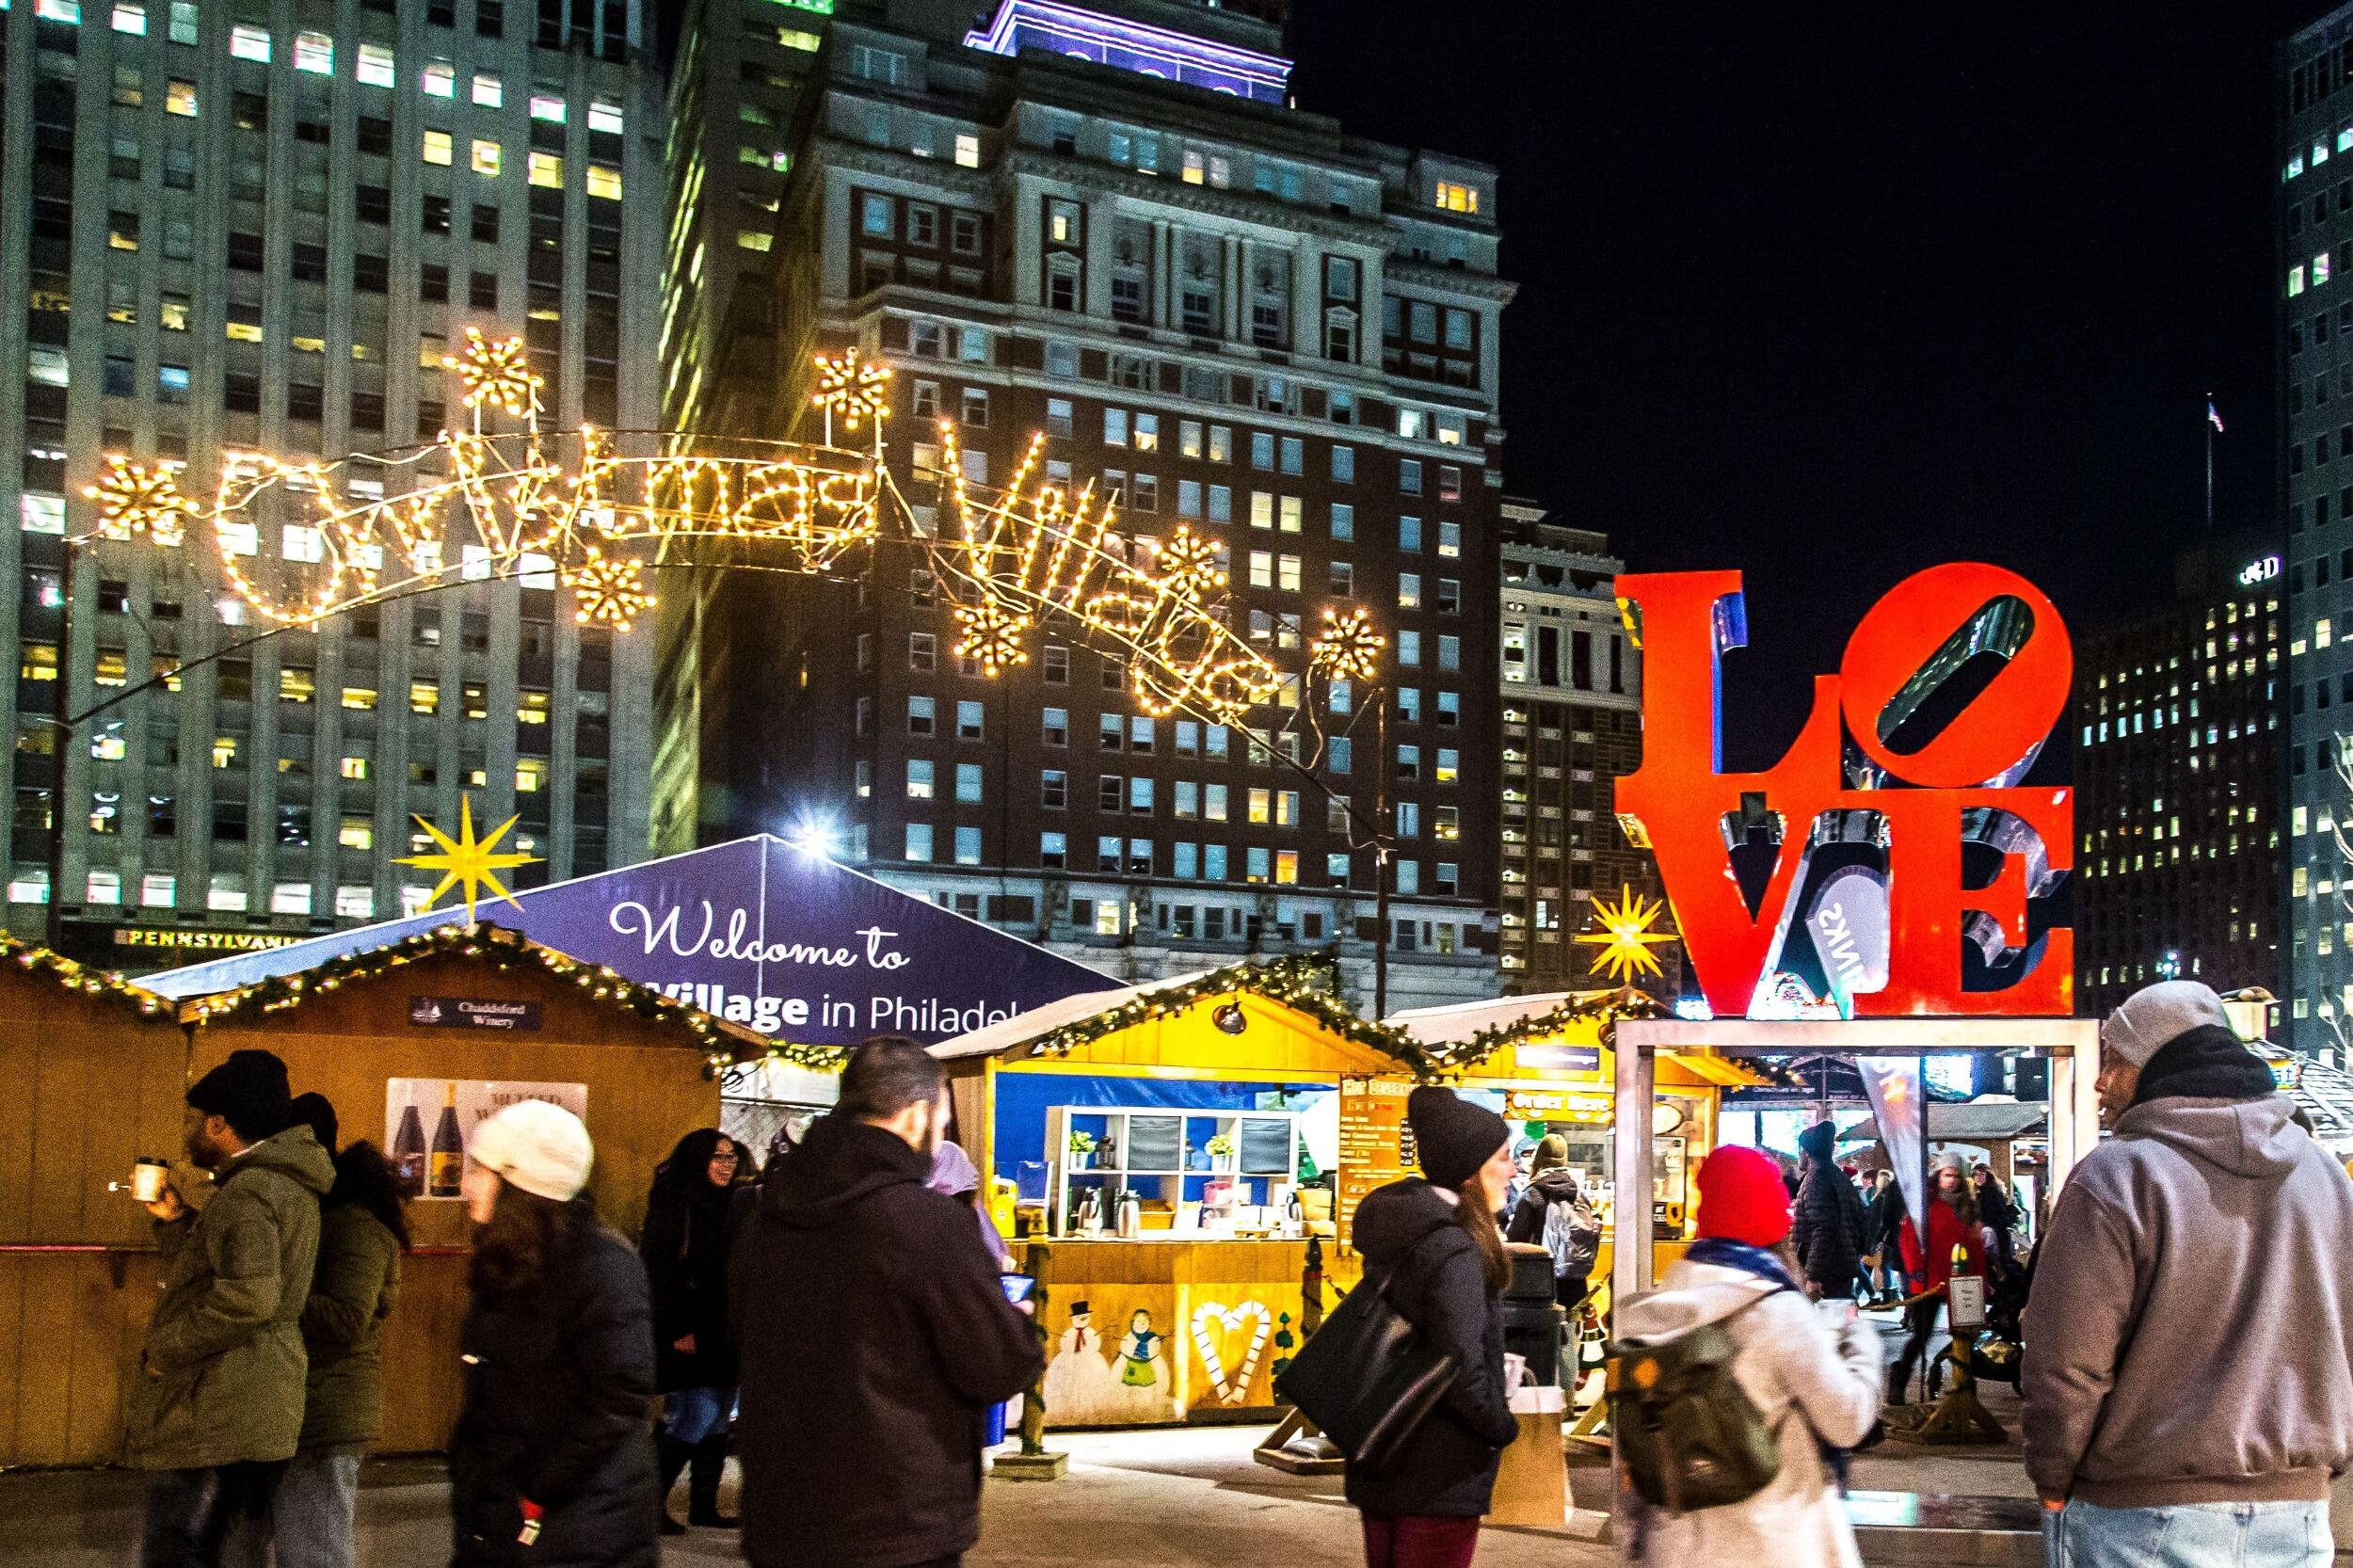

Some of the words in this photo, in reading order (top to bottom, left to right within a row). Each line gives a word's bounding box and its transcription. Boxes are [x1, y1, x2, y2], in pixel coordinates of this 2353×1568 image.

[128, 929, 303, 950] PENNSYLVANI
[610, 900, 858, 968] Welcome
[855, 926, 911, 969] to
[822, 993, 856, 1028] in
